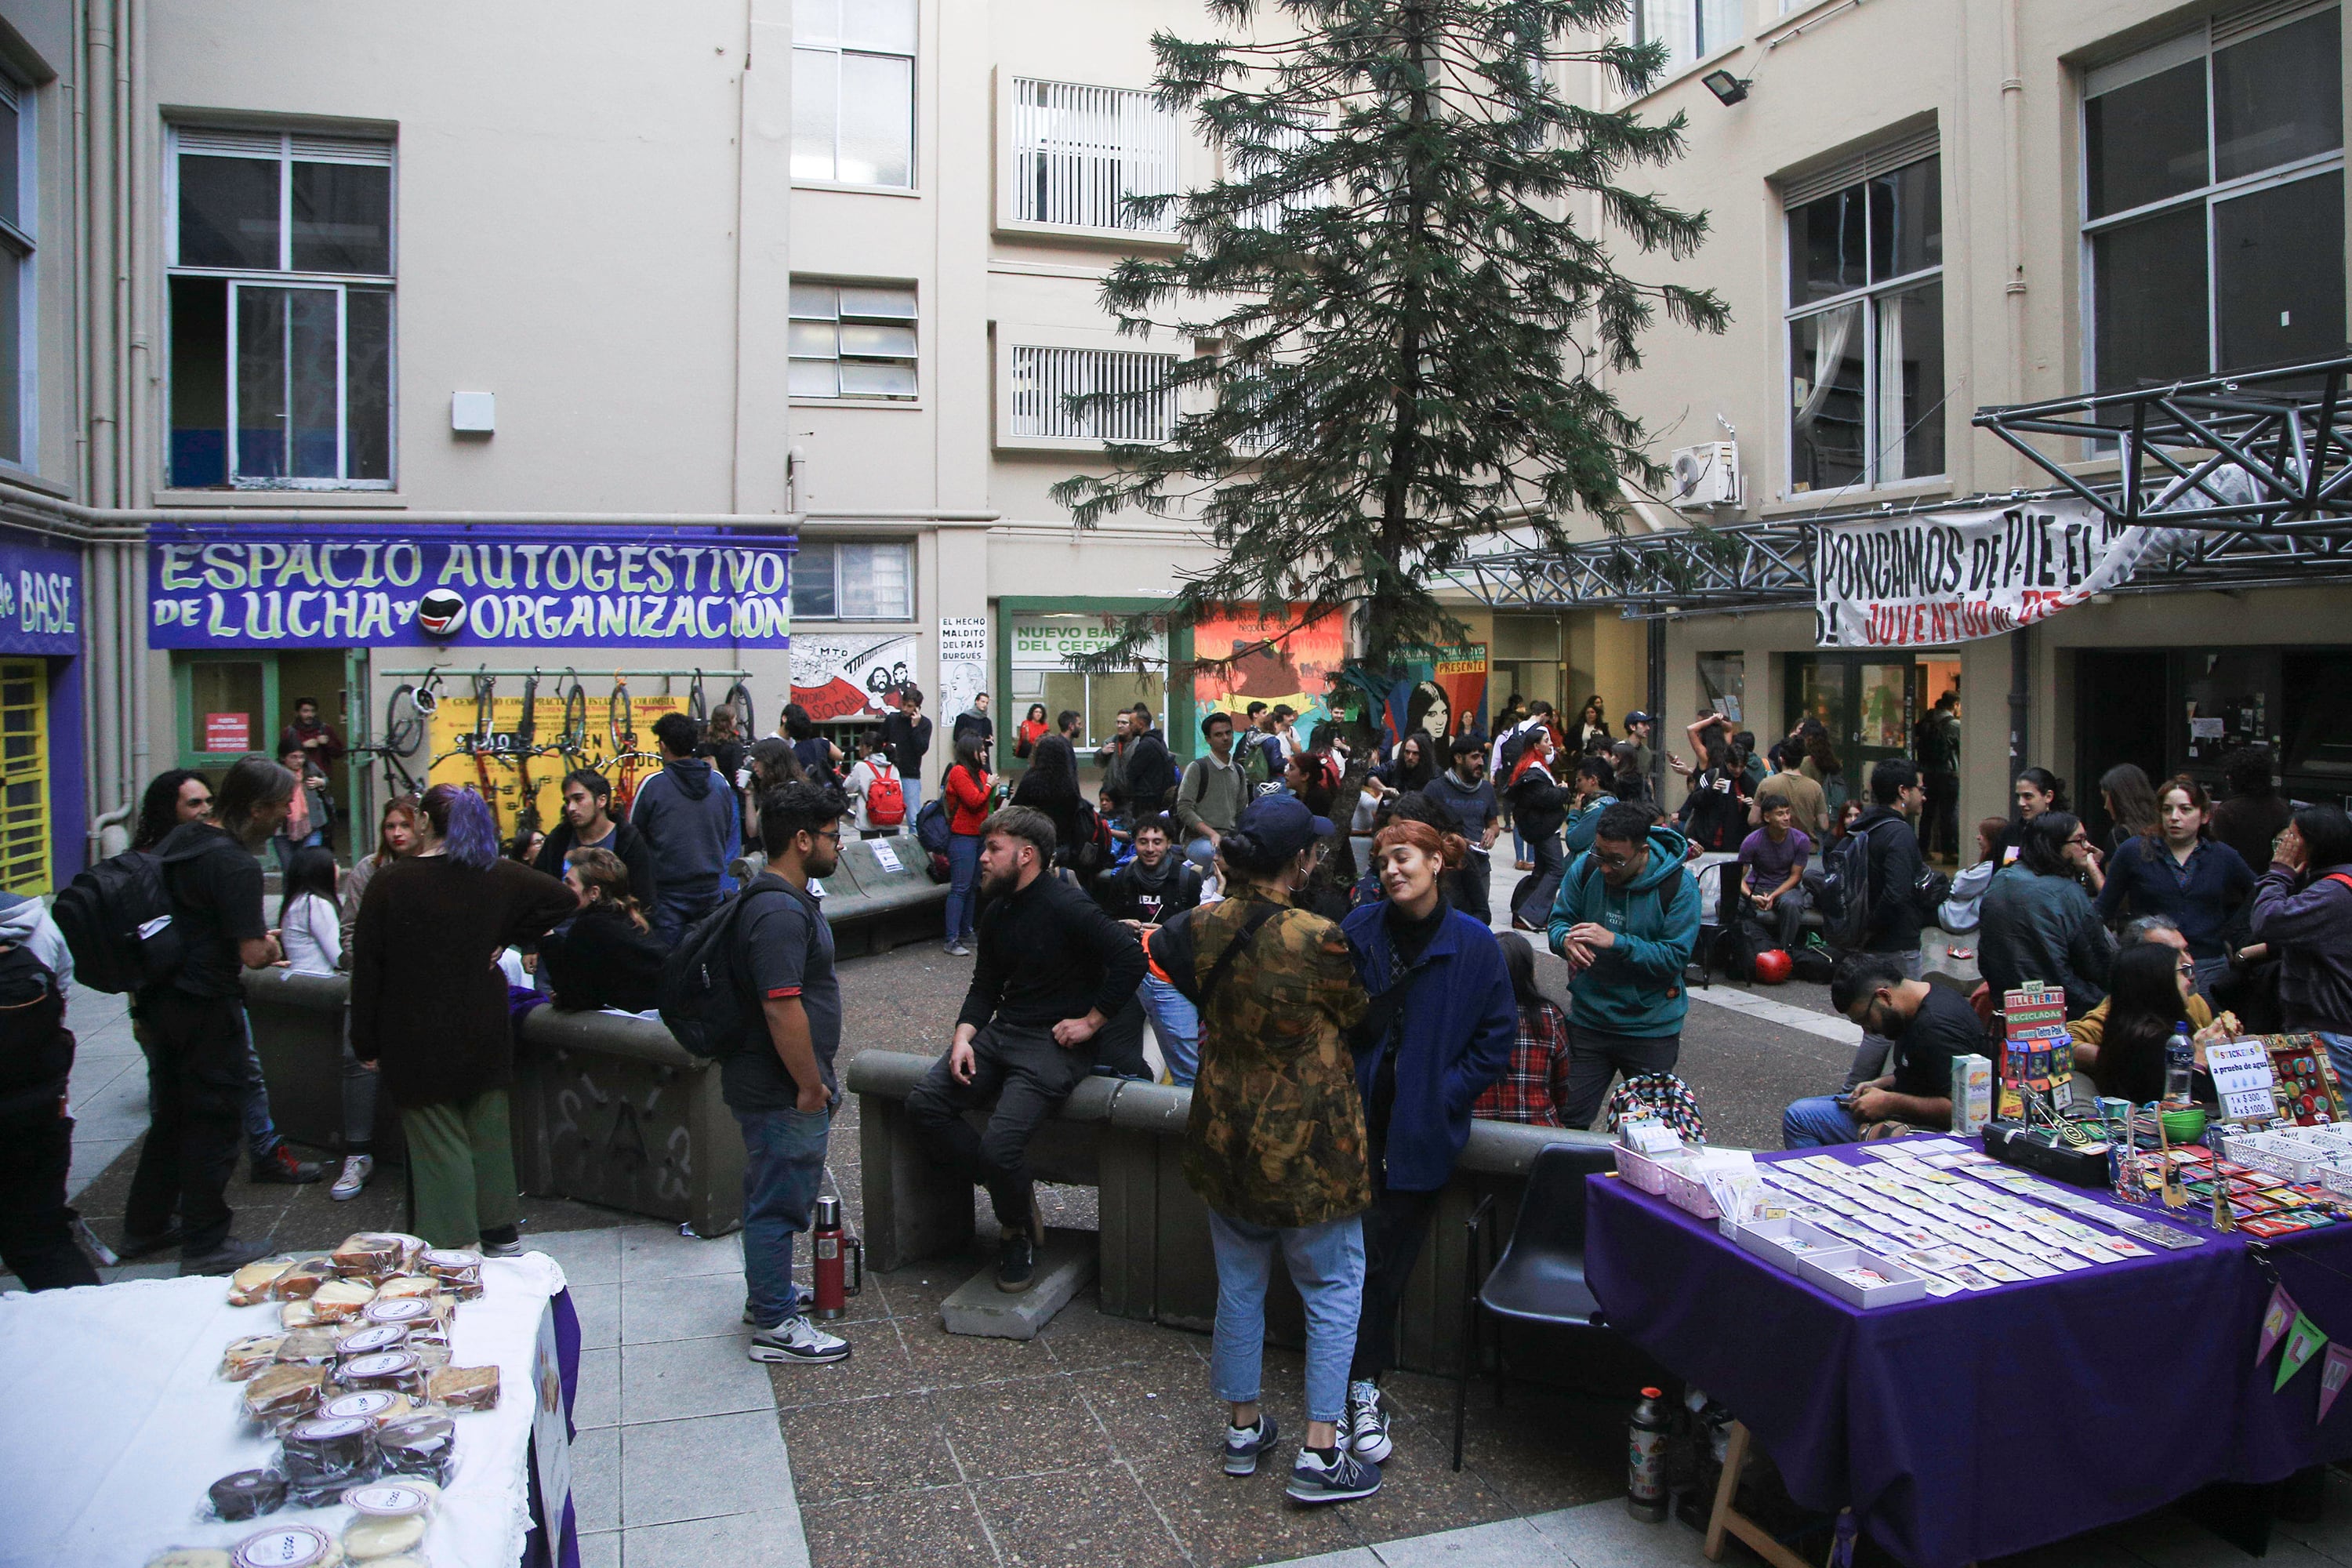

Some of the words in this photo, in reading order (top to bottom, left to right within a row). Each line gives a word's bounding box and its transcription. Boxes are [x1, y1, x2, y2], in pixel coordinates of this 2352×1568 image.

[1820, 526, 1962, 601] PONGAMOS
[2003, 510, 2056, 586] PIE
[159, 539, 423, 591] ESPACIO
[437, 544, 784, 594] AUTOGESTIVO
[20, 569, 76, 634] BASE
[154, 599, 201, 626] DE
[207, 590, 395, 639] LUCHA
[470, 590, 790, 639] ORGANIZACIÓN
[942, 629, 985, 637] MALDITO
[1018, 627, 1081, 638] NUEVO
[1087, 627, 1123, 638] BAR
[1018, 640, 1052, 652] DEL
[820, 648, 848, 657] MTD
[1439, 661, 1483, 673] PRESENTE
[811, 691, 862, 720] SOCIAL
[2008, 1011, 2063, 1023] RECICLADAS
[2036, 1027, 2052, 1038] Tetra
[2052, 1025, 2063, 1036] Pak
[2220, 1047, 2256, 1059] STICKERS
[2220, 1064, 2243, 1076] prueba
[2244, 1062, 2252, 1071] de
[2252, 1061, 2268, 1072] agua
